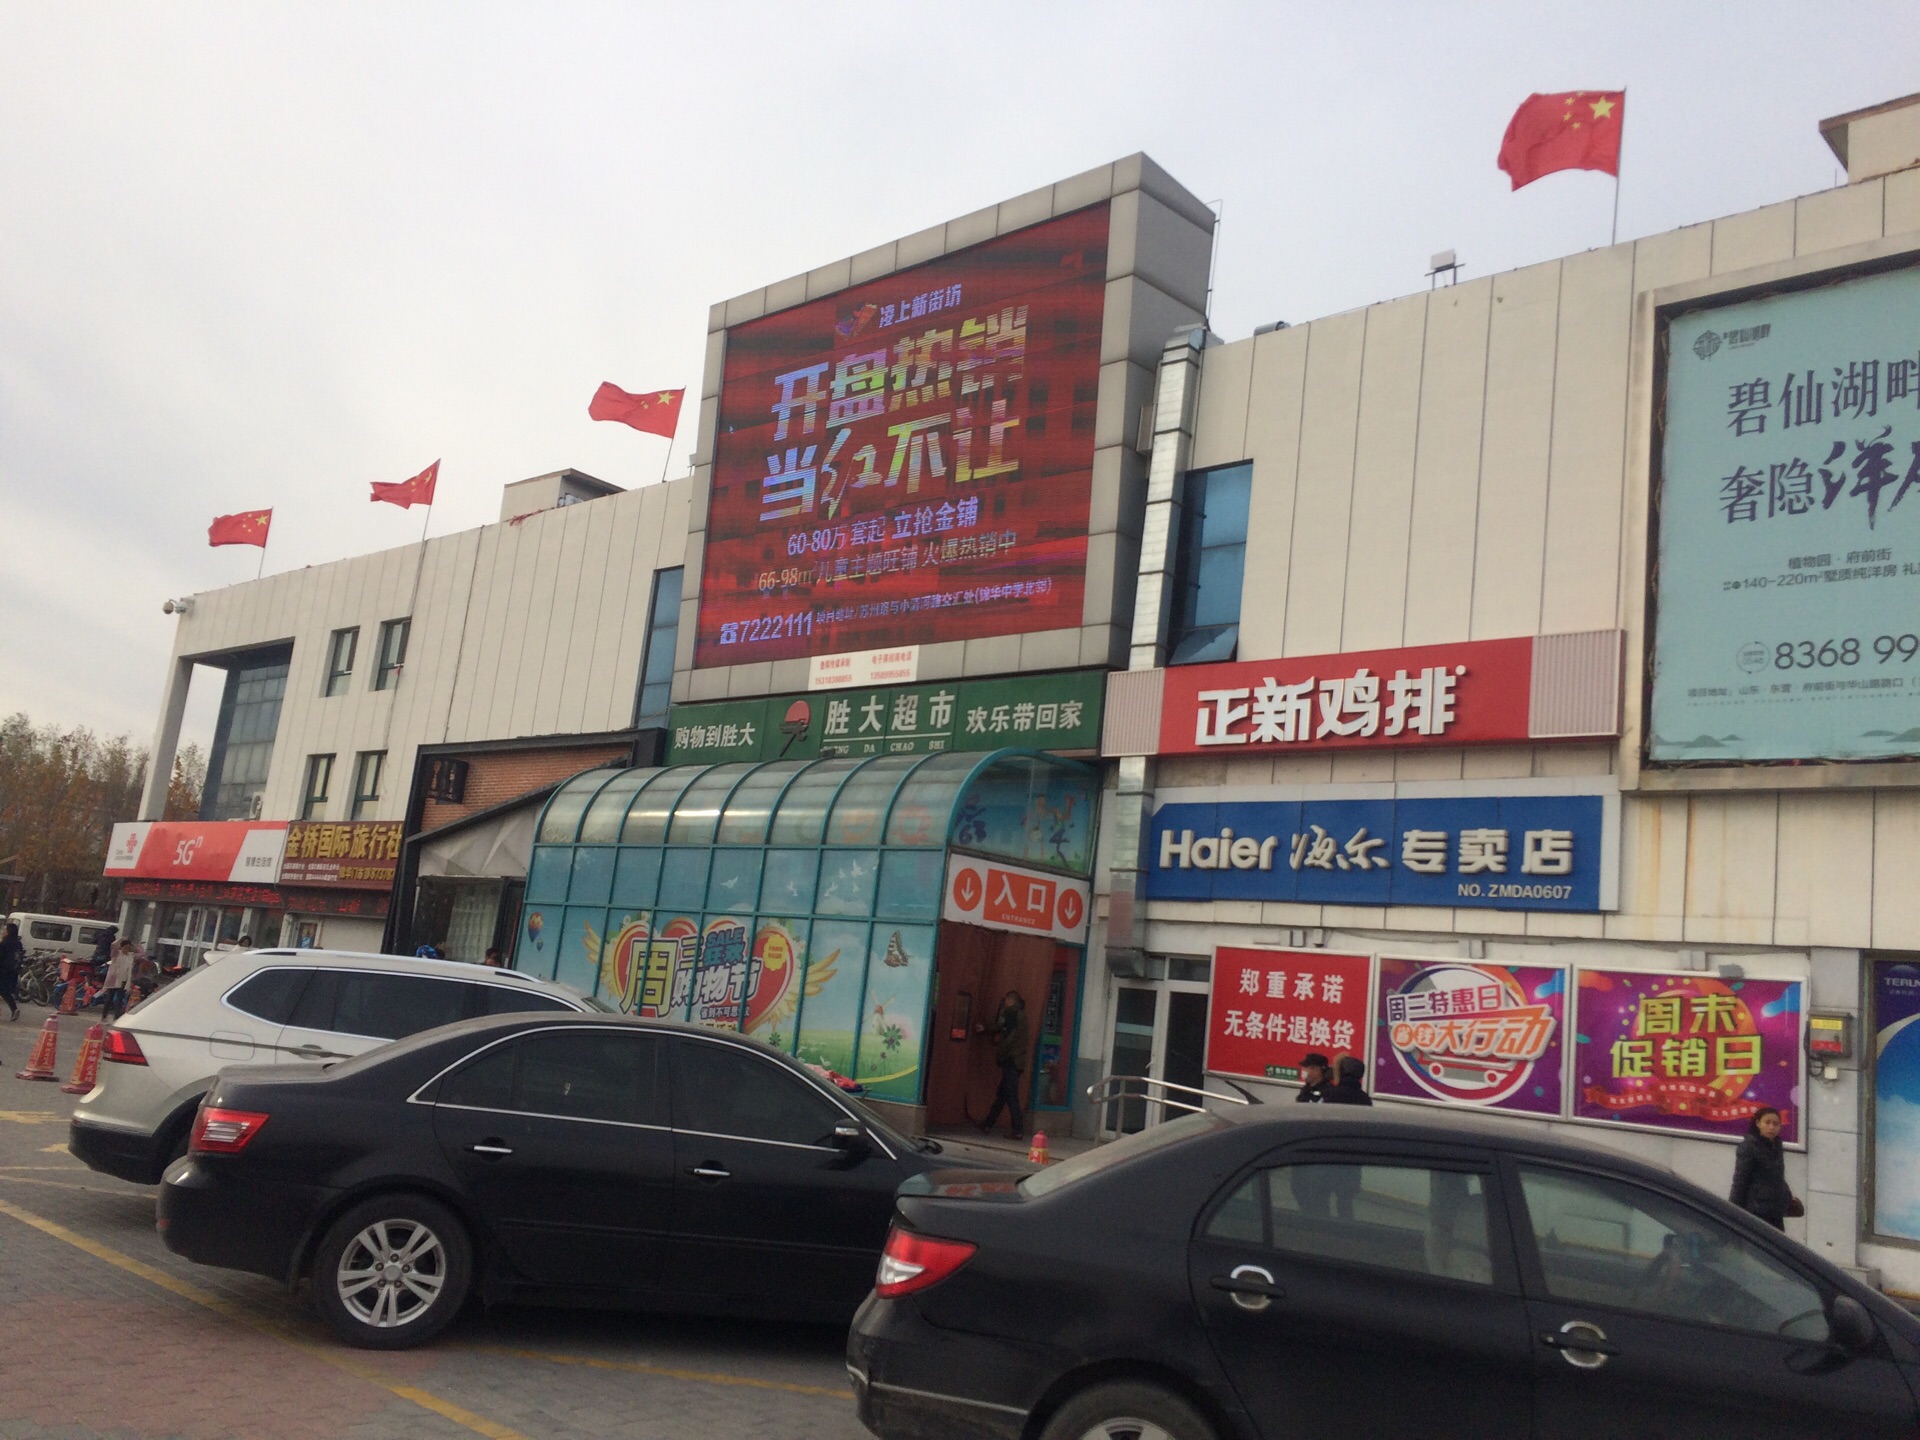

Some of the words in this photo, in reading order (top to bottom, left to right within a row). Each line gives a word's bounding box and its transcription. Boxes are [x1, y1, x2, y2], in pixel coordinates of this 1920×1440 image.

[770, 303, 1029, 442] 开盘热销
[759, 398, 1020, 522] 当红不让
[891, 496, 979, 540] 立抢金铺
[739, 611, 813, 643] 7222111
[1774, 637, 1861, 670] 8368
[824, 689, 956, 736] 胜大超市
[965, 700, 1083, 734] 欢乐带回家
[1195, 667, 1457, 746] 正新鸡排
[674, 722, 756, 750] 购物到胜大
[863, 744, 876, 754] DA
[889, 742, 915, 753] CHAO
[928, 740, 946, 750] SHI
[285, 823, 403, 860] 金桥国际旅行社
[1159, 827, 1278, 870] Haier
[1288, 824, 1392, 871] 海尔
[1401, 829, 1574, 876] 专卖店
[993, 874, 1047, 913] 入口
[706, 927, 745, 948] SALE
[1001, 913, 1036, 925] ENTRANCE
[671, 959, 761, 1008] 购物节
[1239, 968, 1344, 1004] 郑重承诺
[1388, 984, 1502, 1022] 周三特惠日
[1224, 1009, 1355, 1050] 无条件退换货
[1393, 1006, 1551, 1056] 省钱大行动
[1637, 994, 1736, 1036] 周末
[1610, 1035, 1761, 1078] 促销日
